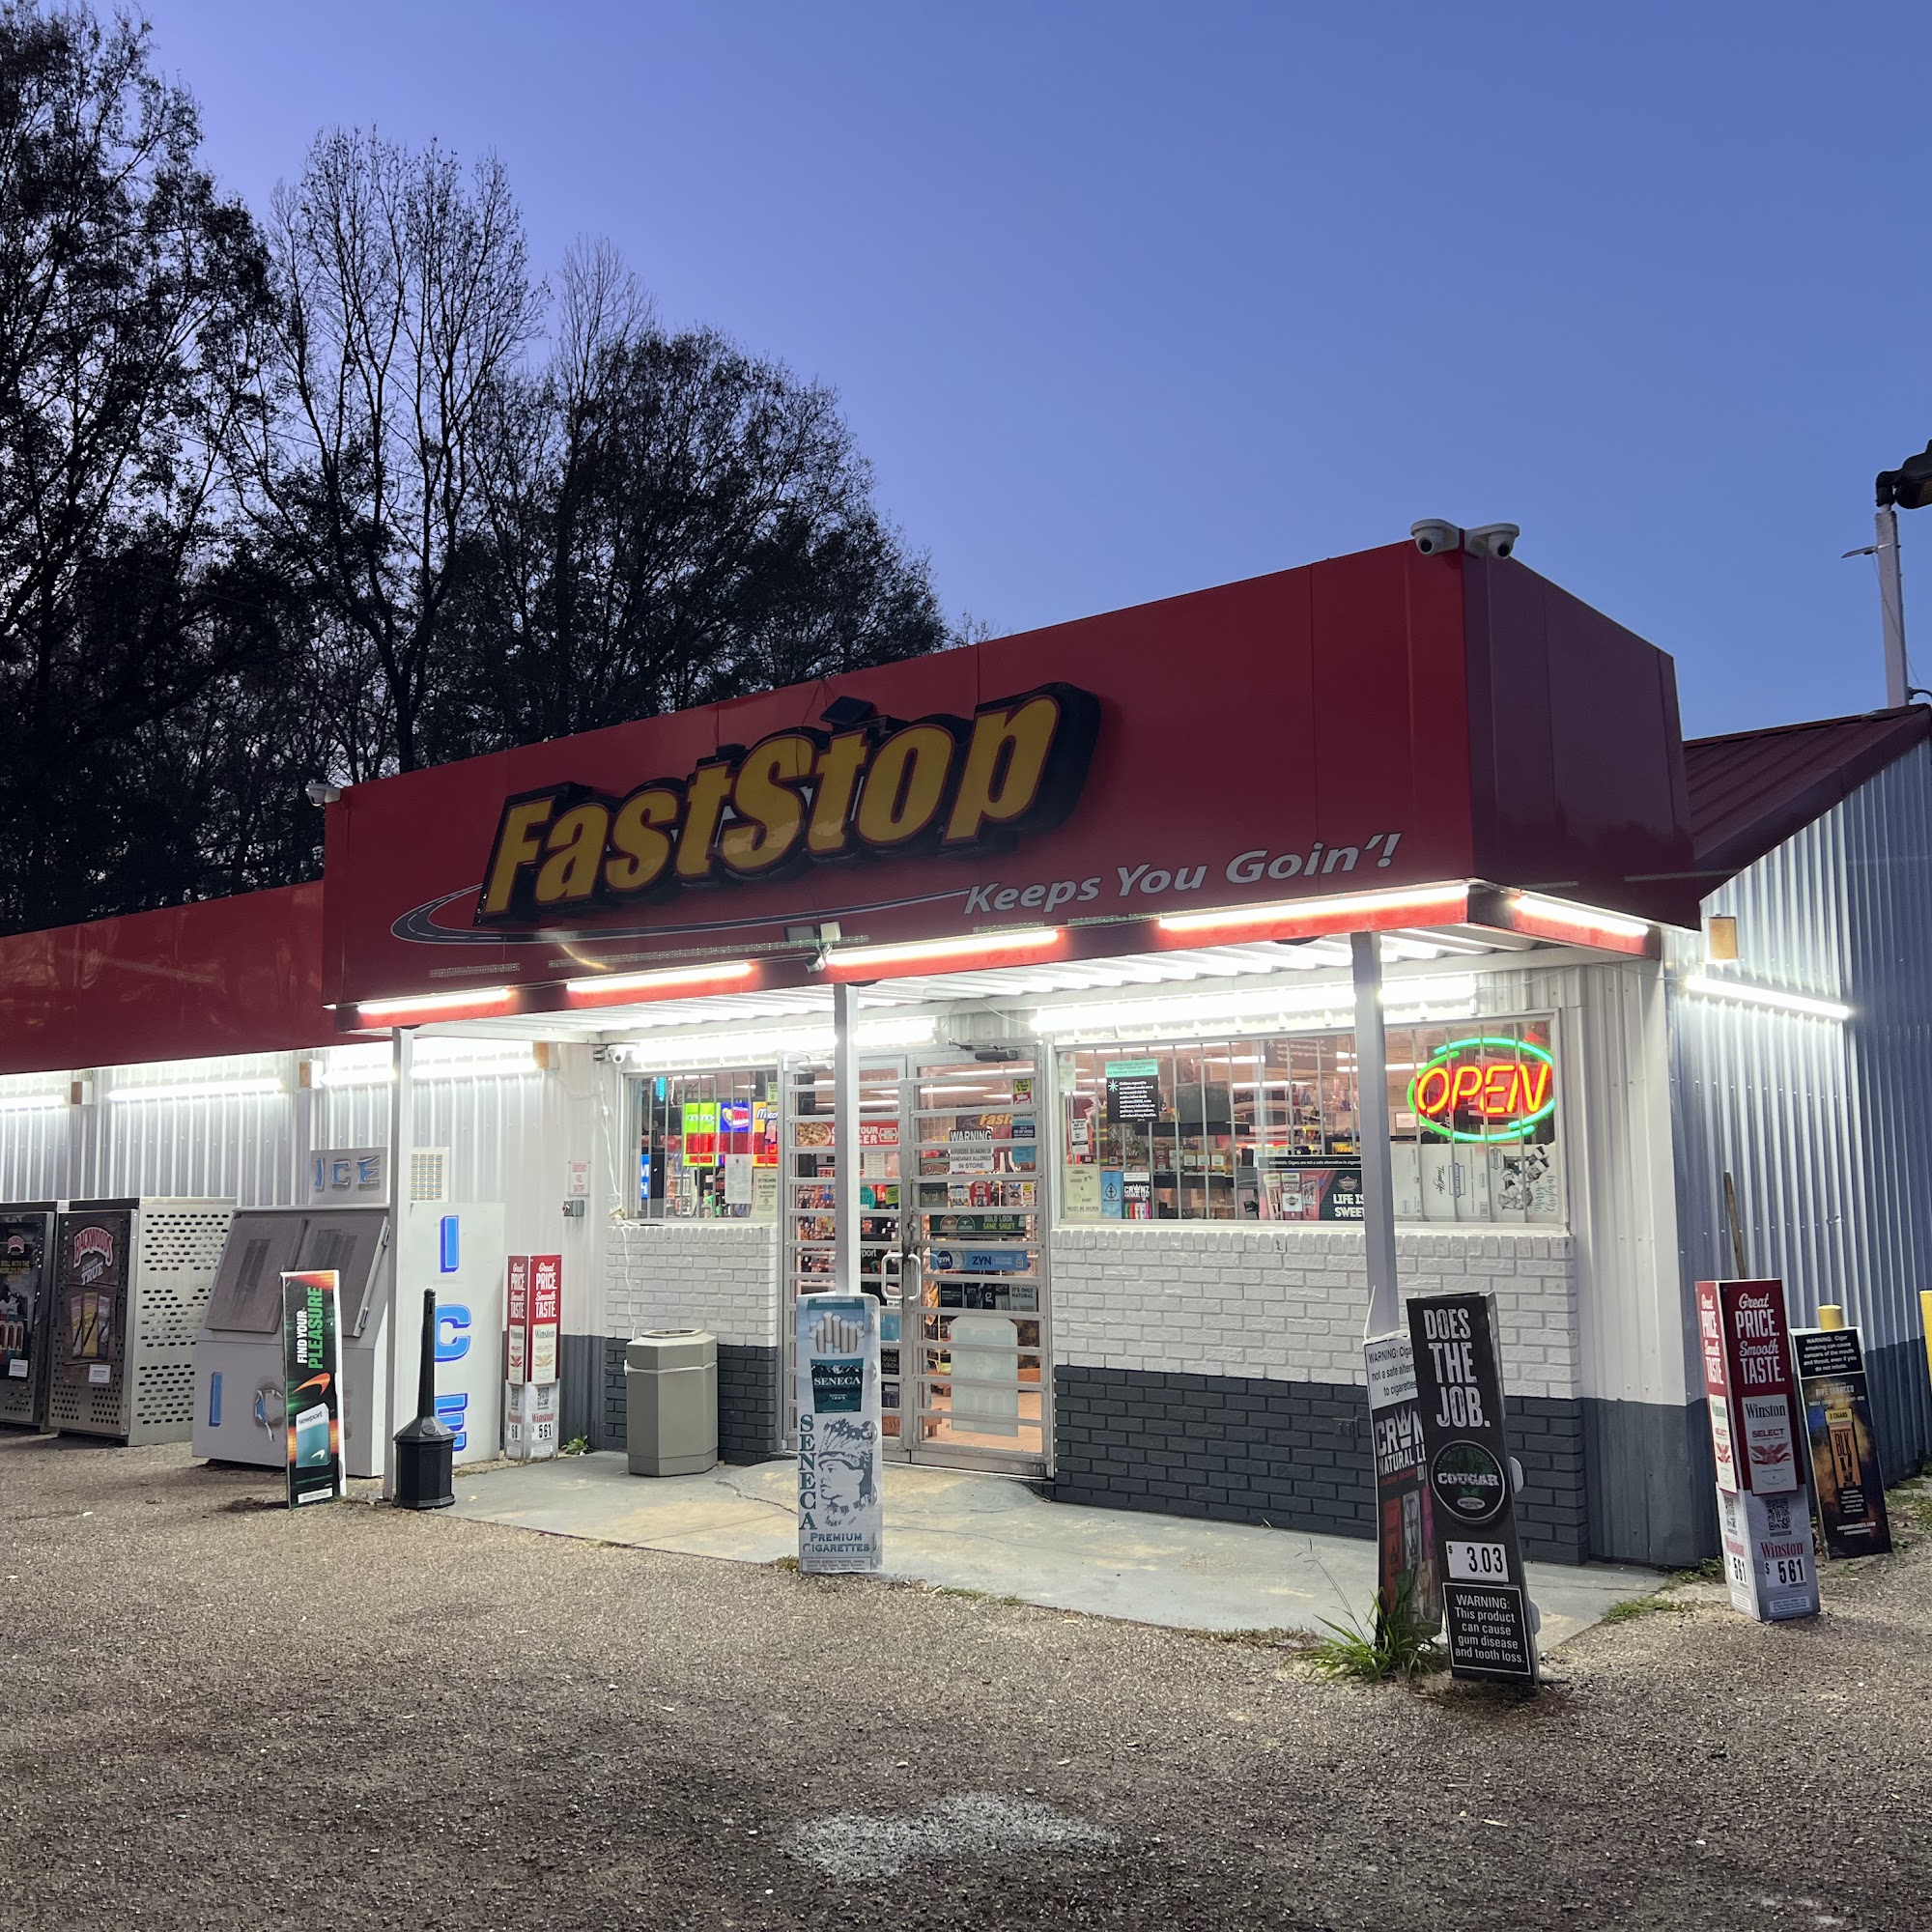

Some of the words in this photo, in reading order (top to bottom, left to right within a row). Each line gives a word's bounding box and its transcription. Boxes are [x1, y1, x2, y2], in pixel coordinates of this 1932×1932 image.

[485, 694, 1061, 914] FastStop
[964, 875, 1101, 914] Keeps
[1116, 865, 1208, 897] You
[1417, 1063, 1549, 1116] OPEN
[951, 1130, 992, 1141] WARNING
[314, 1154, 381, 1190] ICE
[1333, 1193, 1353, 1204] LIFE
[1739, 1293, 1770, 1309] Great
[297, 1310, 307, 1340] YOUR
[306, 1287, 324, 1369] PLEASURE
[1423, 1308, 1472, 1340] DOES
[1735, 1308, 1780, 1339] PRICE.
[297, 1340, 307, 1364] FIND
[1739, 1338, 1779, 1356] Smooth
[1369, 1348, 1399, 1364] WARNING:
[1428, 1341, 1478, 1383] THE
[1372, 1369, 1381, 1381] not
[1381, 1371, 1386, 1379] a
[1386, 1365, 1399, 1378] safe
[1740, 1355, 1785, 1384] TASTE.
[813, 1376, 862, 1386] SENECA
[1830, 1385, 1855, 1394] TOBACCO
[1383, 1386, 1390, 1396] to
[1435, 1386, 1491, 1428] JOB.
[1745, 1403, 1786, 1419] Winston
[298, 1410, 323, 1426] Newport
[531, 1413, 554, 1423] Winston
[1752, 1428, 1785, 1438] SELECT
[1378, 1447, 1415, 1477] NATURAL
[798, 1413, 817, 1531] SENECA
[1437, 1472, 1500, 1487] COUGAR
[810, 1532, 863, 1542] PREMIUM
[1760, 1541, 1804, 1559] Winston
[1448, 1545, 1453, 1554] $
[1466, 1546, 1503, 1574] 3.03
[1765, 1562, 1771, 1575] $
[1777, 1558, 1804, 1584] 561
[1456, 1594, 1511, 1609] WARNING:
[1454, 1606, 1476, 1620] This
[1477, 1610, 1516, 1623] product
[1462, 1623, 1480, 1633] can
[1482, 1624, 1512, 1635] cause
[1458, 1635, 1479, 1647] gum
[1480, 1635, 1518, 1649] disease
[1455, 1647, 1473, 1659] and
[1475, 1648, 1500, 1661] tooth
[1501, 1650, 1525, 1663] loss.
